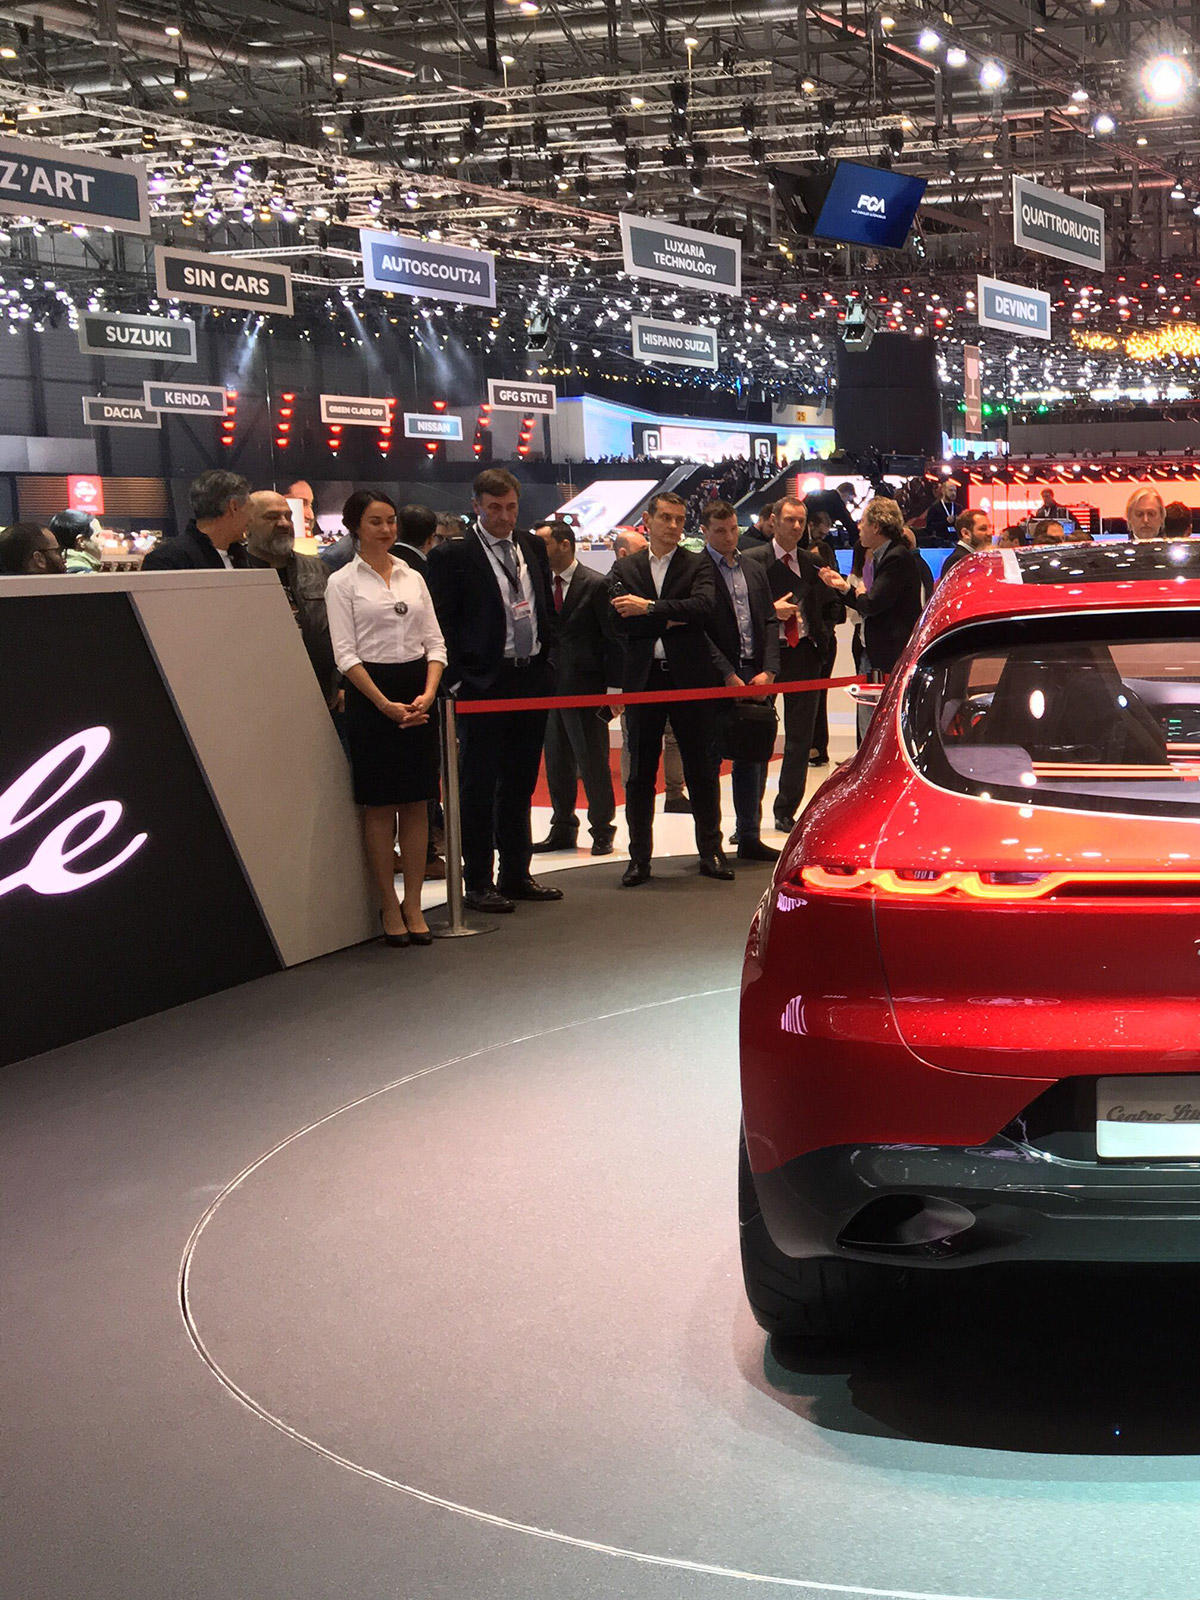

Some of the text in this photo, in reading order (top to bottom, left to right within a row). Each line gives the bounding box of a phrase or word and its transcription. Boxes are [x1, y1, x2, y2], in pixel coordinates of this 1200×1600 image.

[857, 194, 885, 213] FCA
[1022, 204, 1100, 247] QUATTRORUOTE
[664, 239, 706, 259] LUXARIA
[381, 254, 481, 286] AUTOSCOUT24
[652, 251, 717, 276] TECHNOLOGY
[183, 266, 270, 296] SIN CARS
[995, 295, 1038, 322] DEVINCI
[105, 325, 172, 348] SUZUKI
[642, 332, 712, 353] HISPANO SUIZA
[164, 391, 211, 407] KENDA
[499, 389, 548, 405] GFG STYLE
[103, 406, 143, 420] DACIA
[351, 406, 371, 416] CLASS
[417, 420, 451, 433] NISSAN
[1106, 1105, 1166, 1122] Centro
